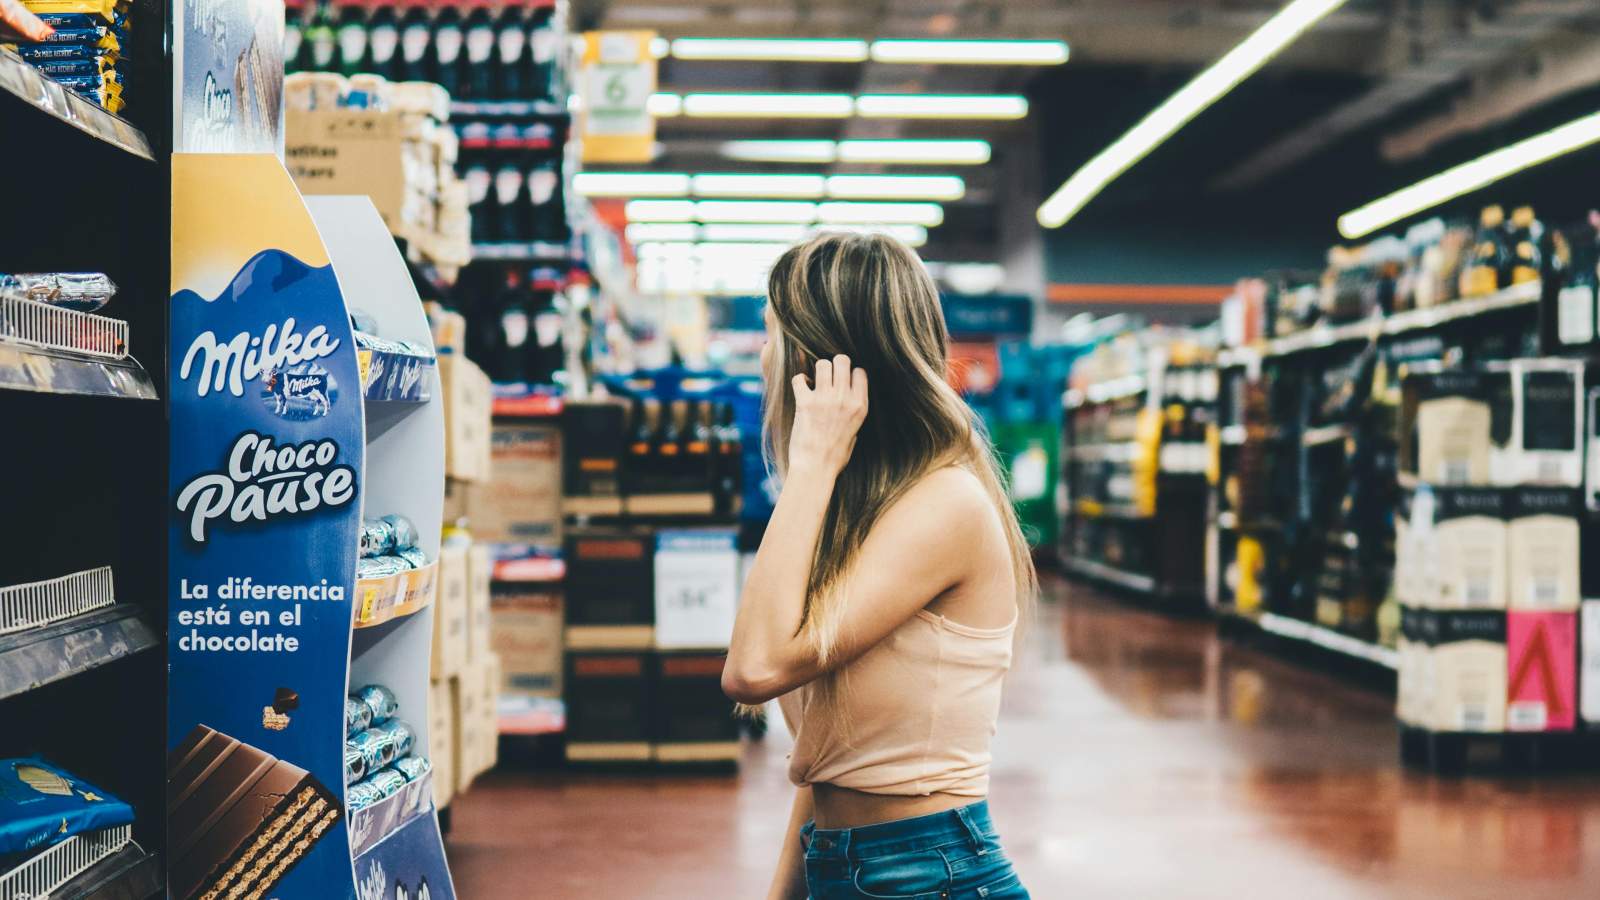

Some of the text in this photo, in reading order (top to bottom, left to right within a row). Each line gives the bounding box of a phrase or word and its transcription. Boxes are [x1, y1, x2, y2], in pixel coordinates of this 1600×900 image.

[180, 317, 340, 397] Milka
[289, 376, 322, 393] Milka
[228, 433, 336, 483] Choco
[176, 467, 353, 542] Pause
[181, 576, 345, 601] La diferencia
[178, 603, 301, 626] está en el
[178, 628, 299, 652] chocolate
